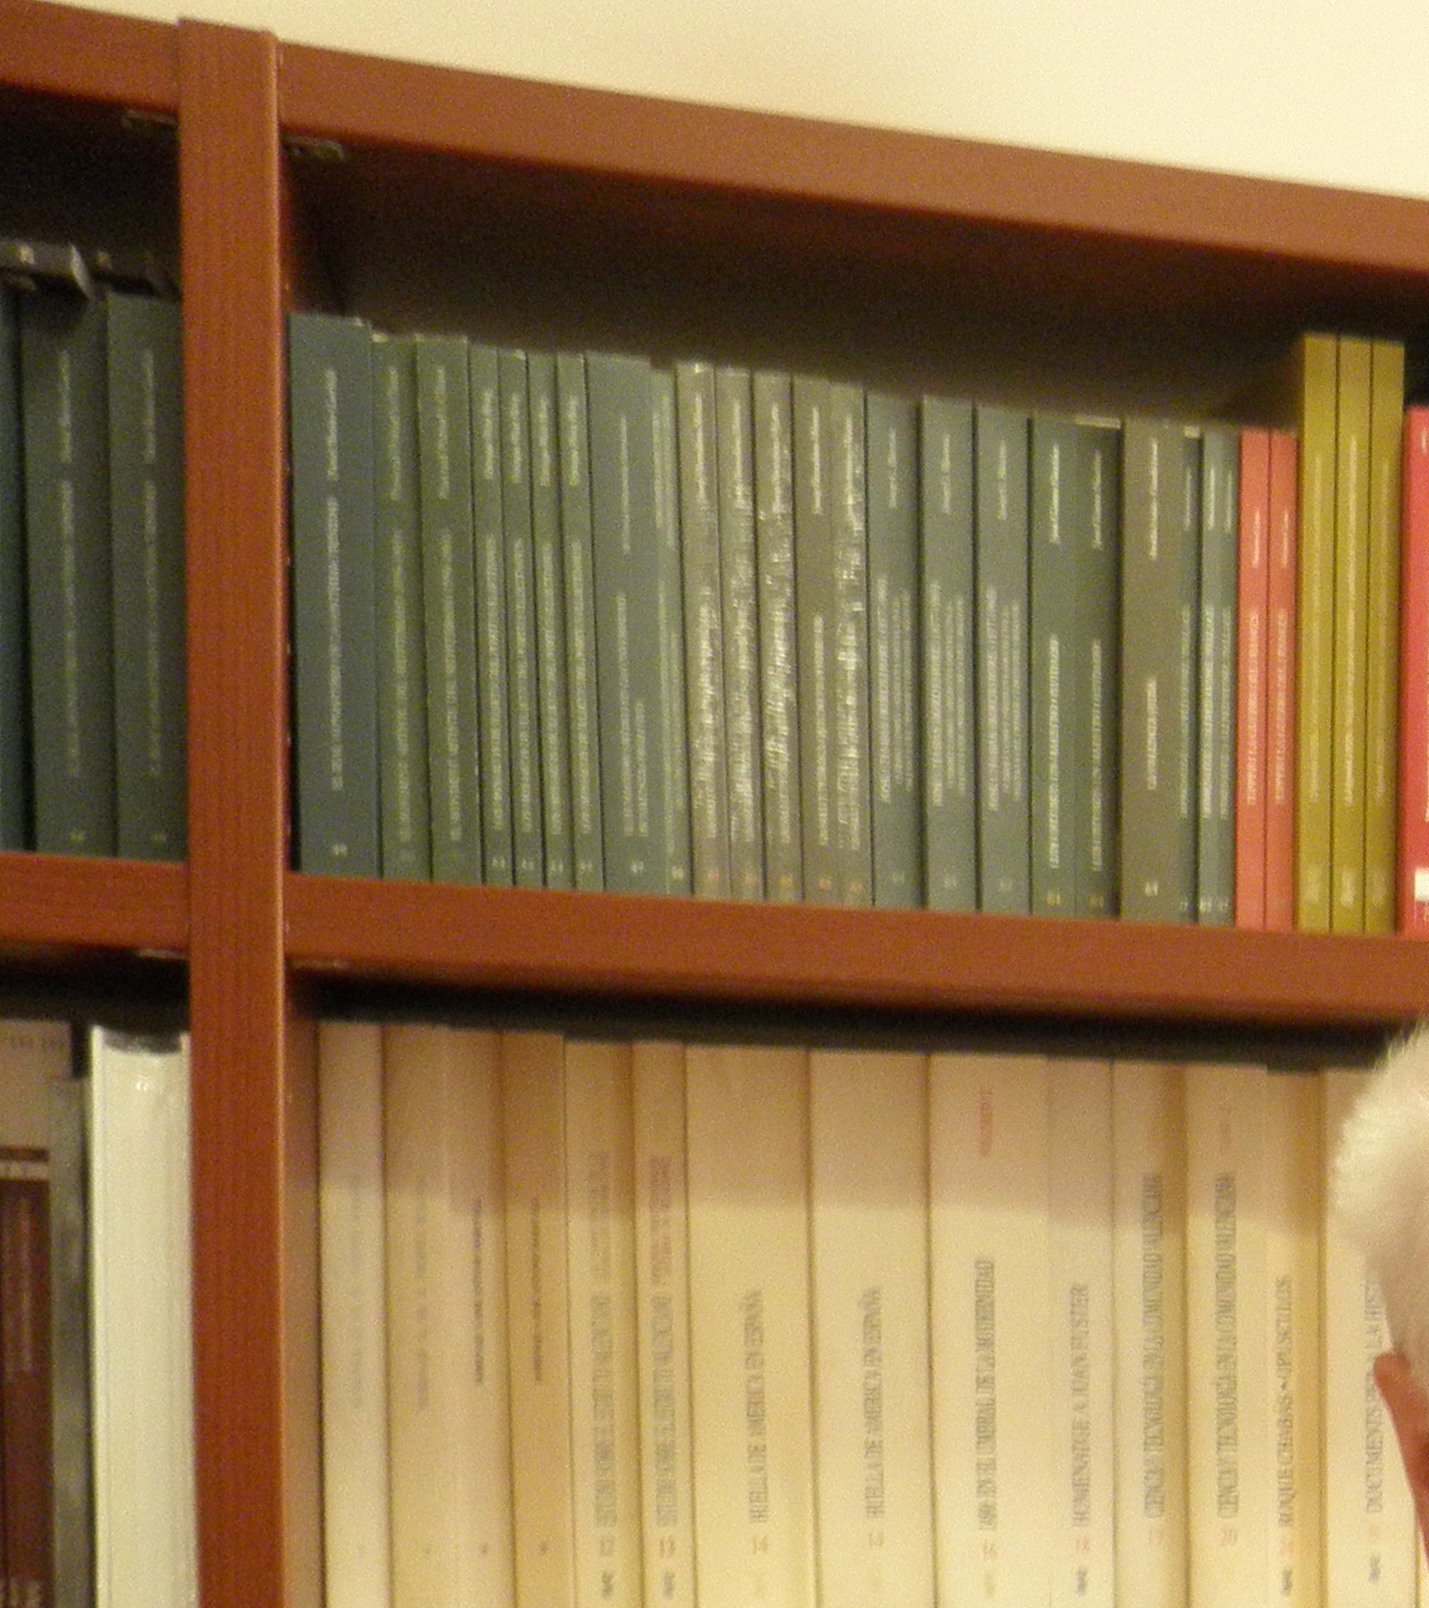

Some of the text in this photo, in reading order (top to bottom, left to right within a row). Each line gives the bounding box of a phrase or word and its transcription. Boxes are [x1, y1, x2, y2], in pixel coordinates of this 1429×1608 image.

[1142, 1174, 1163, 1250] VALENCIANA
[1214, 1172, 1237, 1252] VALENCIANA
[740, 1289, 763, 1347] ESPAÑA
[858, 1286, 882, 1345] ESPAÑA
[975, 1259, 996, 1353] MODERNIDAD
[1069, 1282, 1090, 1353] FUSTER
[1142, 1252, 1163, 1332] COMUNIDAD
[1214, 1253, 1237, 1333] COMUNIDAD
[743, 1350, 765, 1371] EN
[861, 1346, 882, 1368] EN
[746, 1444, 767, 1464] DE
[863, 1439, 884, 1459] DE
[1070, 1418, 1091, 1528] HOMENATGE
[1364, 1407, 1384, 1515] DOCUMENTS
[746, 1465, 769, 1524] HUELLA
[863, 1462, 885, 1518] HUELLA
